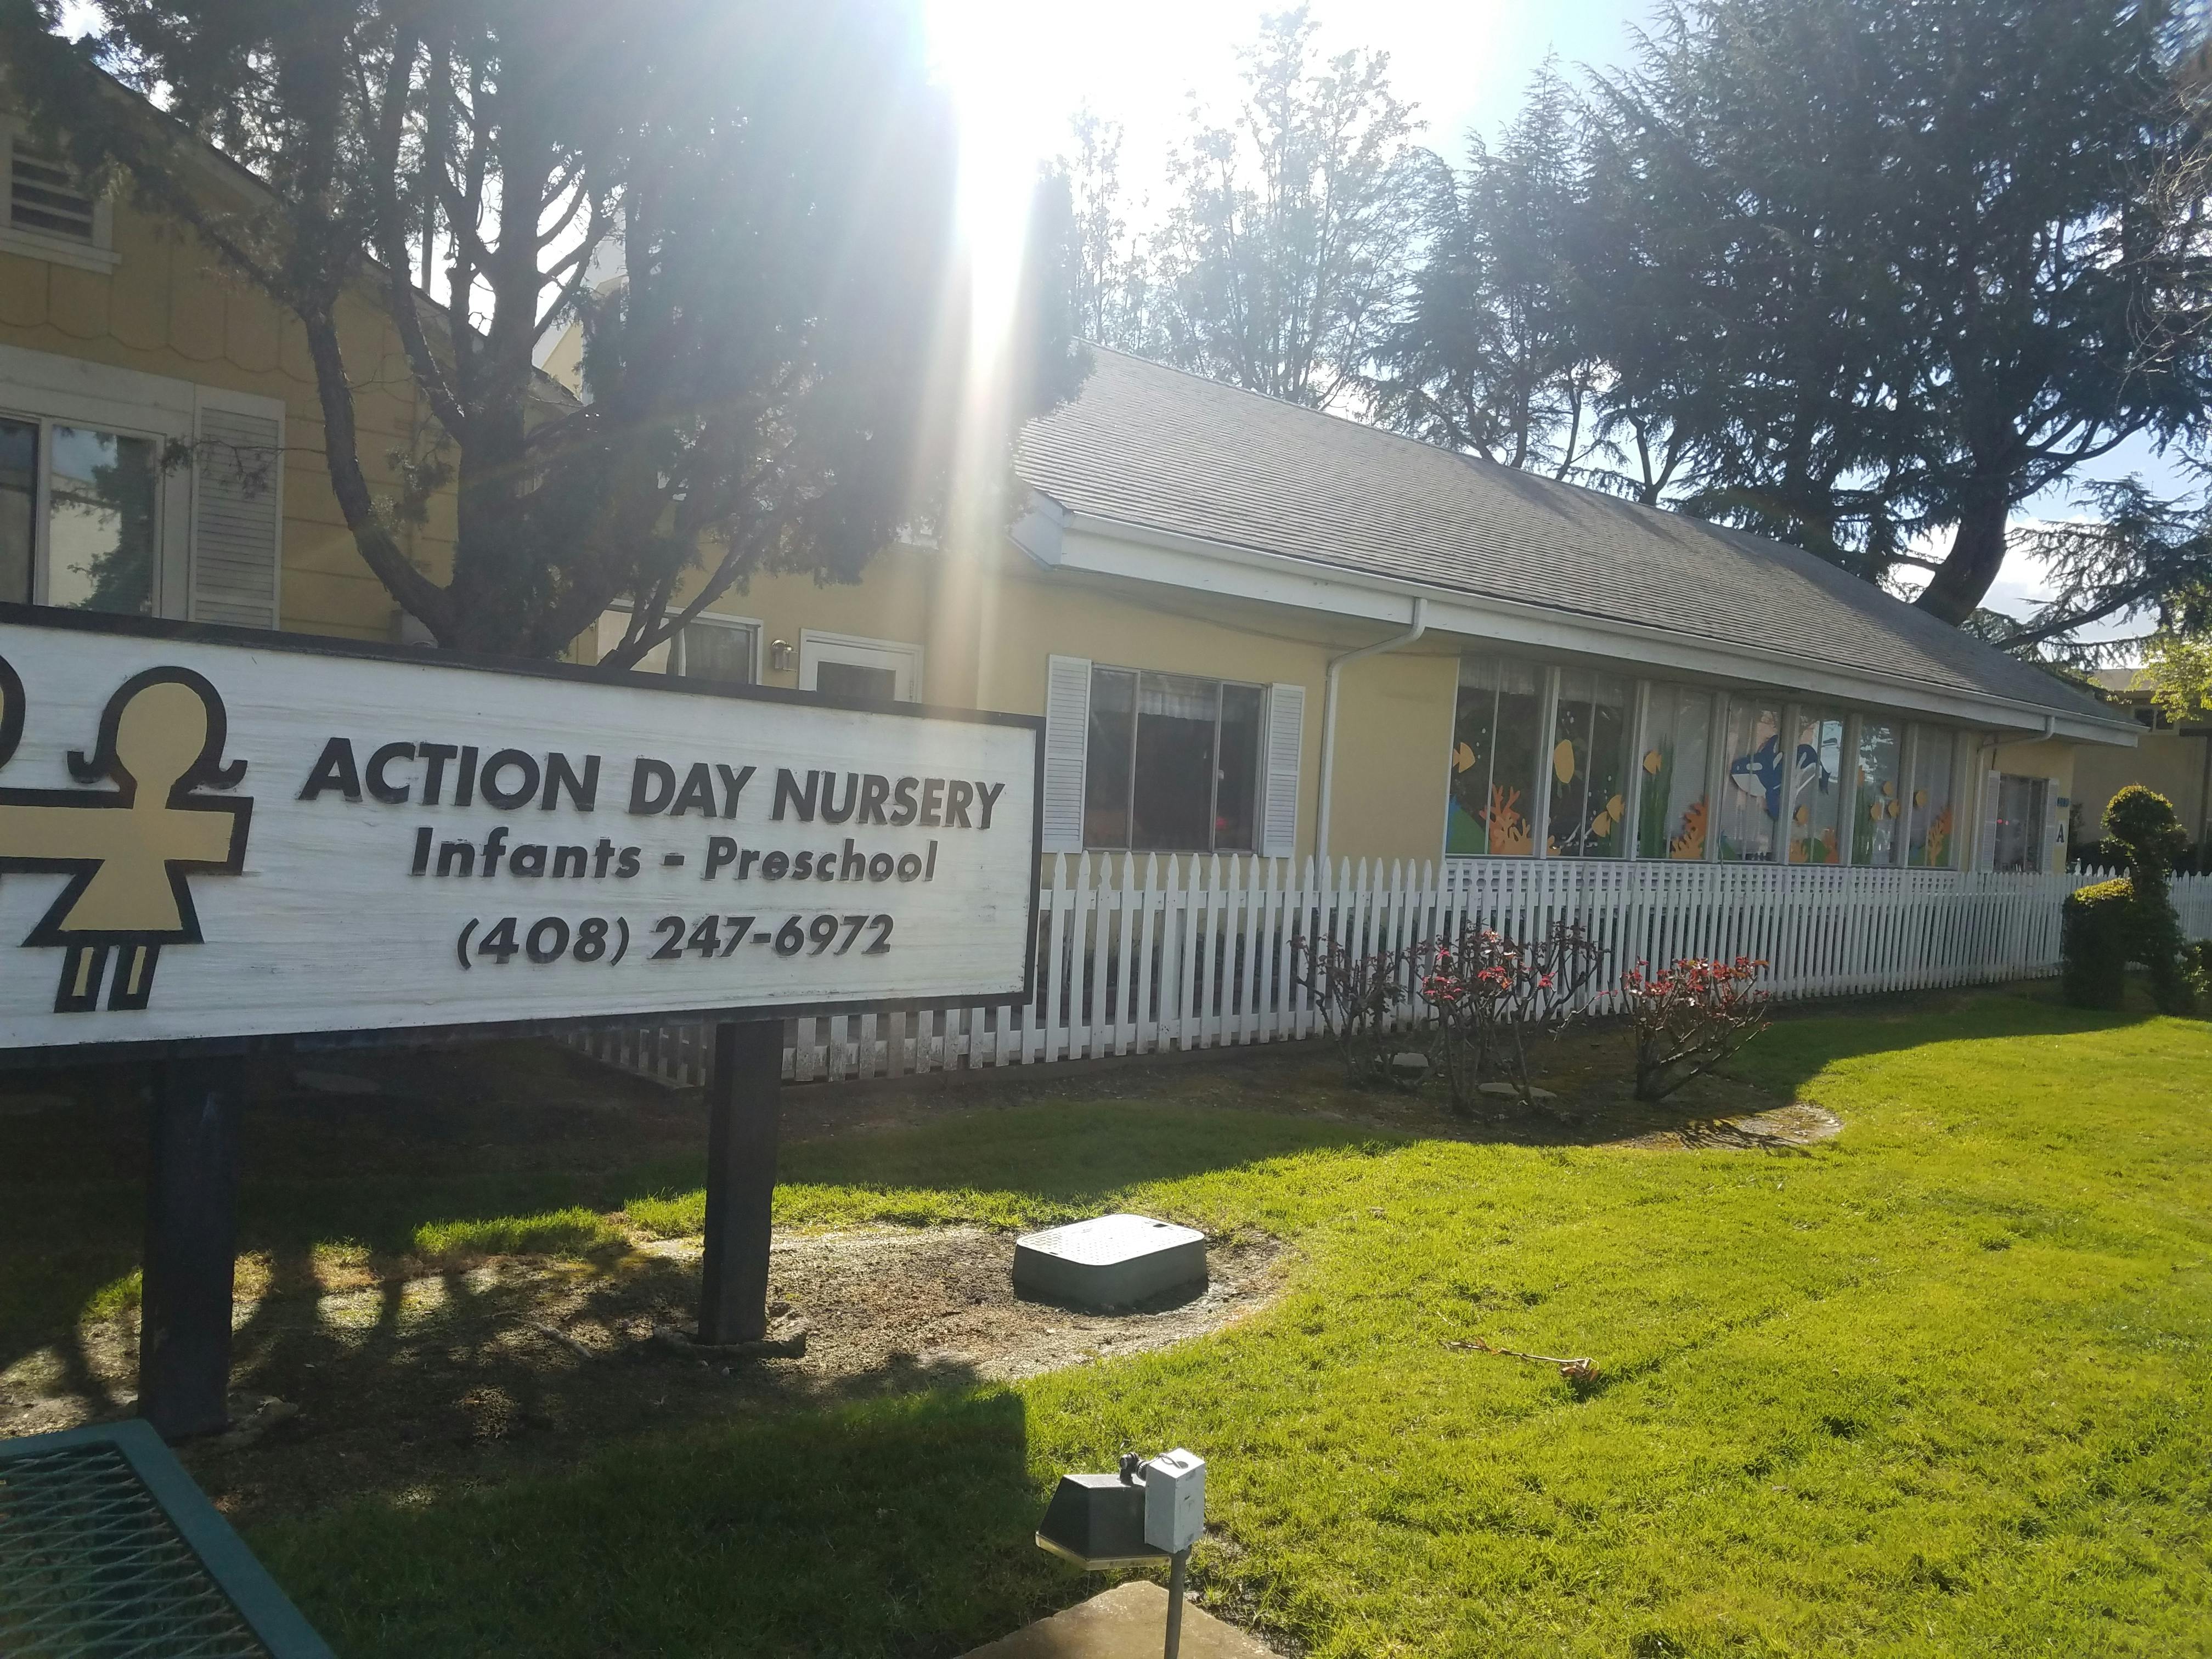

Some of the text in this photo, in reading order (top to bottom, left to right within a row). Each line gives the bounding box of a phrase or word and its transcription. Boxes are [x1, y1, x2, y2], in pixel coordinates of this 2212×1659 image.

[297, 737, 1006, 831] ACTION DAY NURSERY
[410, 826, 642, 879] Infants
[702, 836, 939, 883] Preschool
[2056, 823, 2064, 843] A
[456, 914, 894, 970] (408) 247-6972
